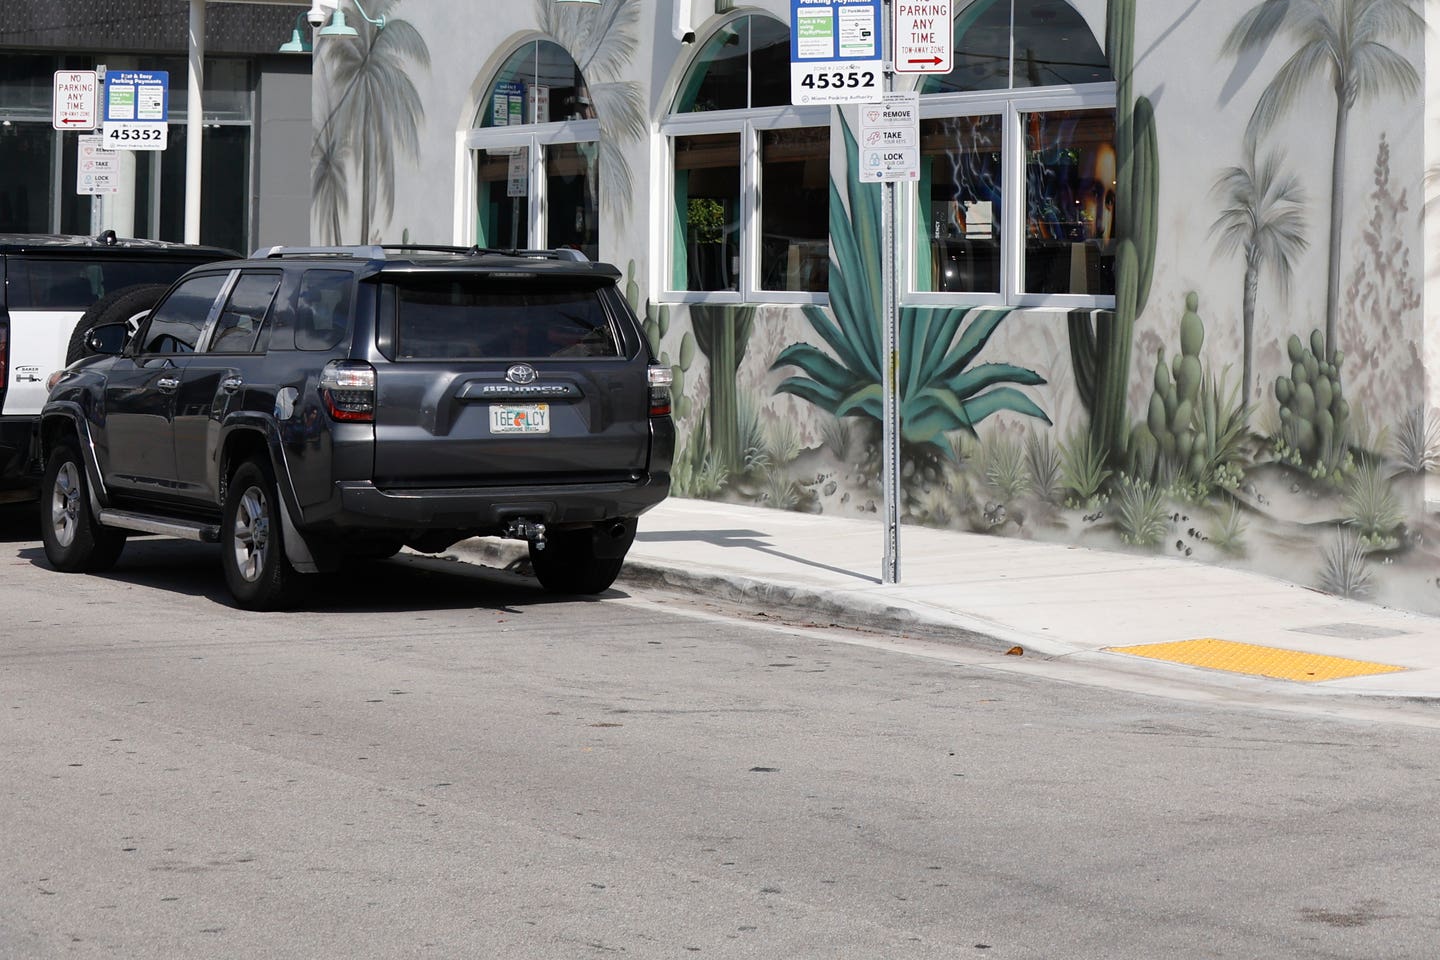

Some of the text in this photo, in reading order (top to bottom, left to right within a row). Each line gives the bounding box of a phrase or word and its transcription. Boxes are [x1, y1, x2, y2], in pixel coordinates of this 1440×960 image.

[899, 5, 947, 16] PARKING
[912, 19, 934, 30] ANY
[911, 32, 936, 44] TIME
[930, 46, 945, 54] ZONE
[70, 74, 82, 83] NO
[801, 71, 875, 89] 45352
[59, 84, 93, 92] PARKING
[67, 93, 83, 101] ANY
[66, 102, 84, 110] TIME
[882, 110, 911, 118] REMOVE
[110, 129, 162, 140] 45352
[883, 131, 902, 139] TAKE
[883, 153, 904, 161] LOCK
[493, 410, 546, 427] 16E LCY
